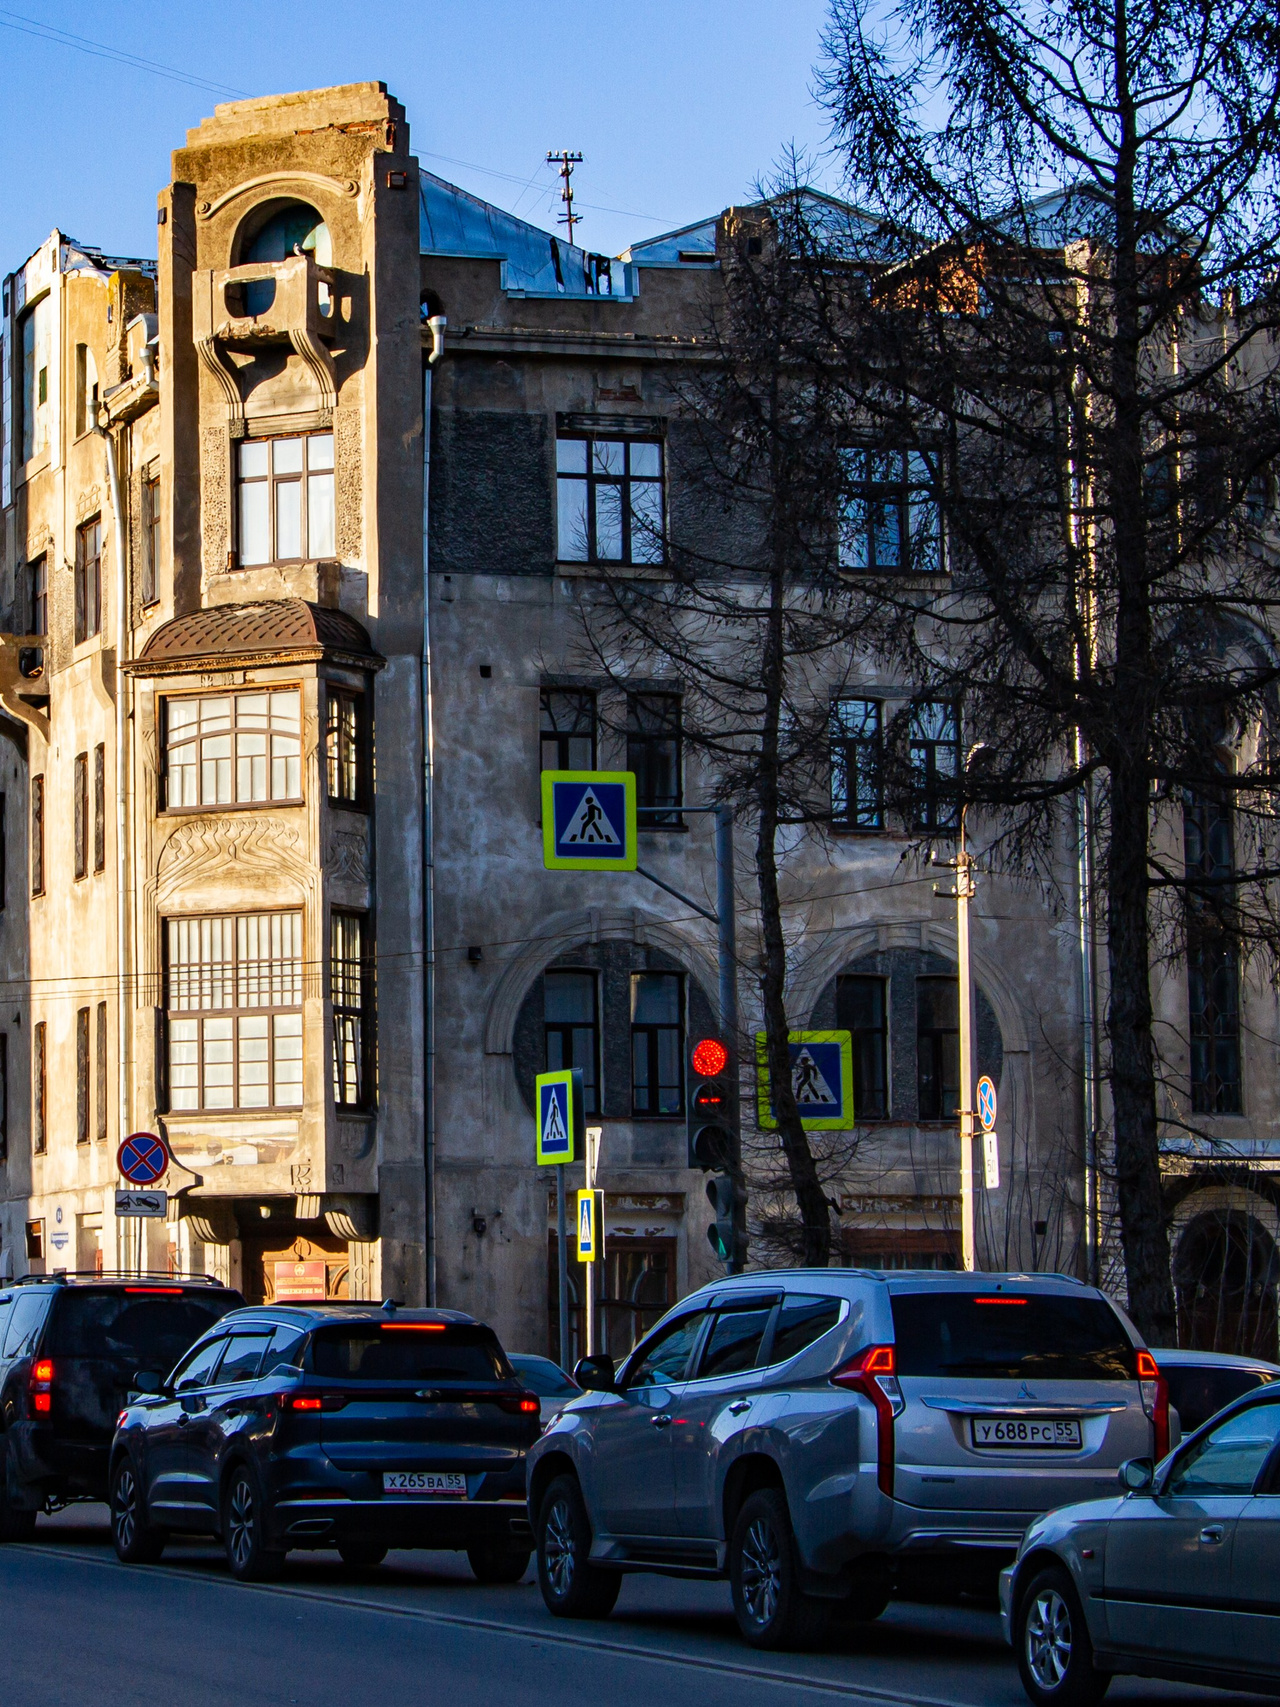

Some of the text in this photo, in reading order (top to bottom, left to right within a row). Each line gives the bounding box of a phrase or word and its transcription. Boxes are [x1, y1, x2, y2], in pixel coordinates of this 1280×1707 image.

[981, 1422, 1073, 1441] У688РС 55
[389, 1473, 461, 1488] Х265ВА 55
